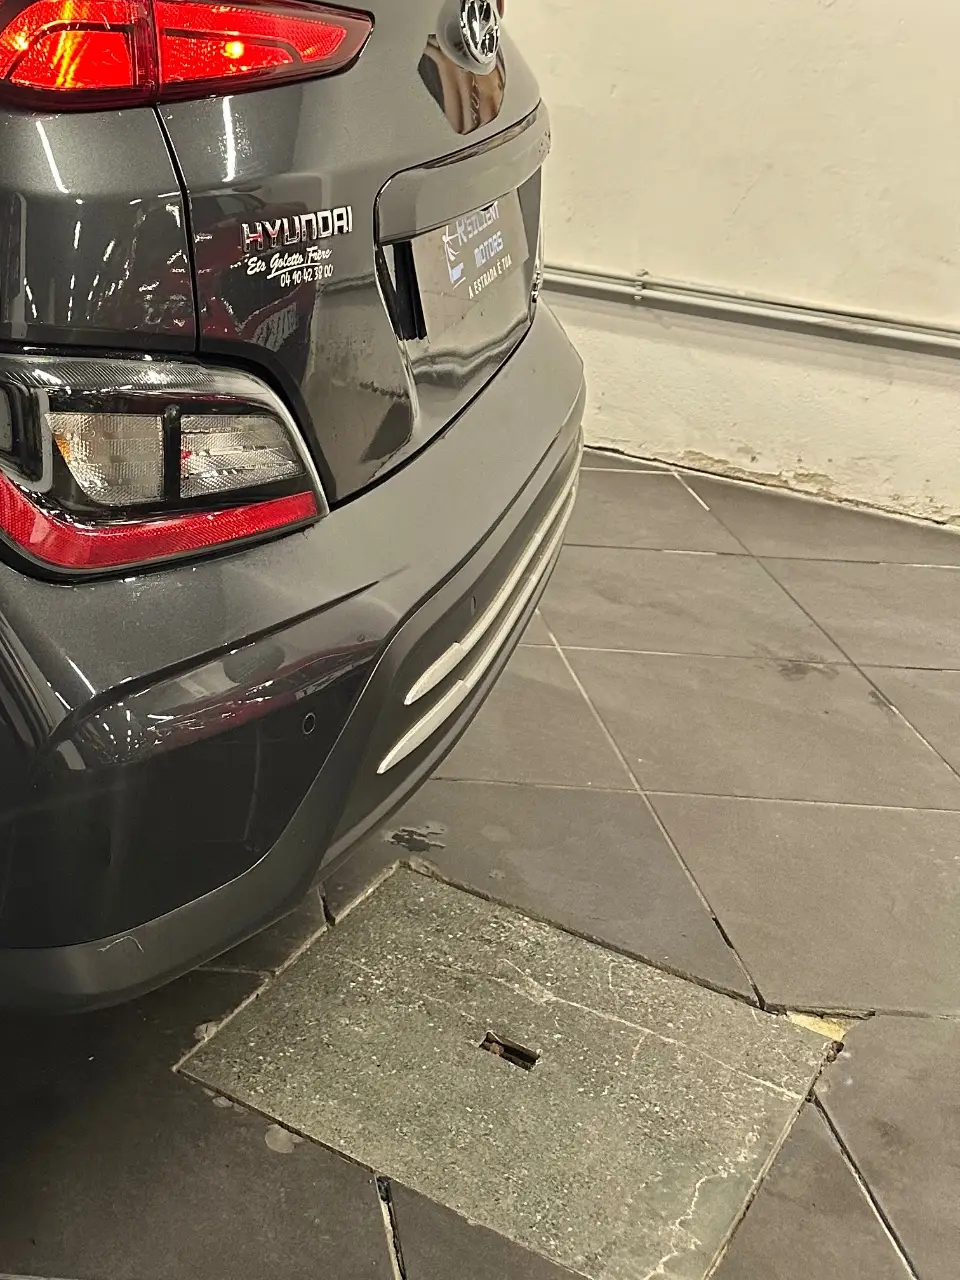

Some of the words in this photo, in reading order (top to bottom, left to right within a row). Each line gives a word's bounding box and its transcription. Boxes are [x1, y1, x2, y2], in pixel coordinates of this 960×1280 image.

[241, 205, 353, 253] HYUNDAI
[280, 272, 291, 288] 04
[303, 267, 313, 283] 42
[323, 263, 334, 278] 00
